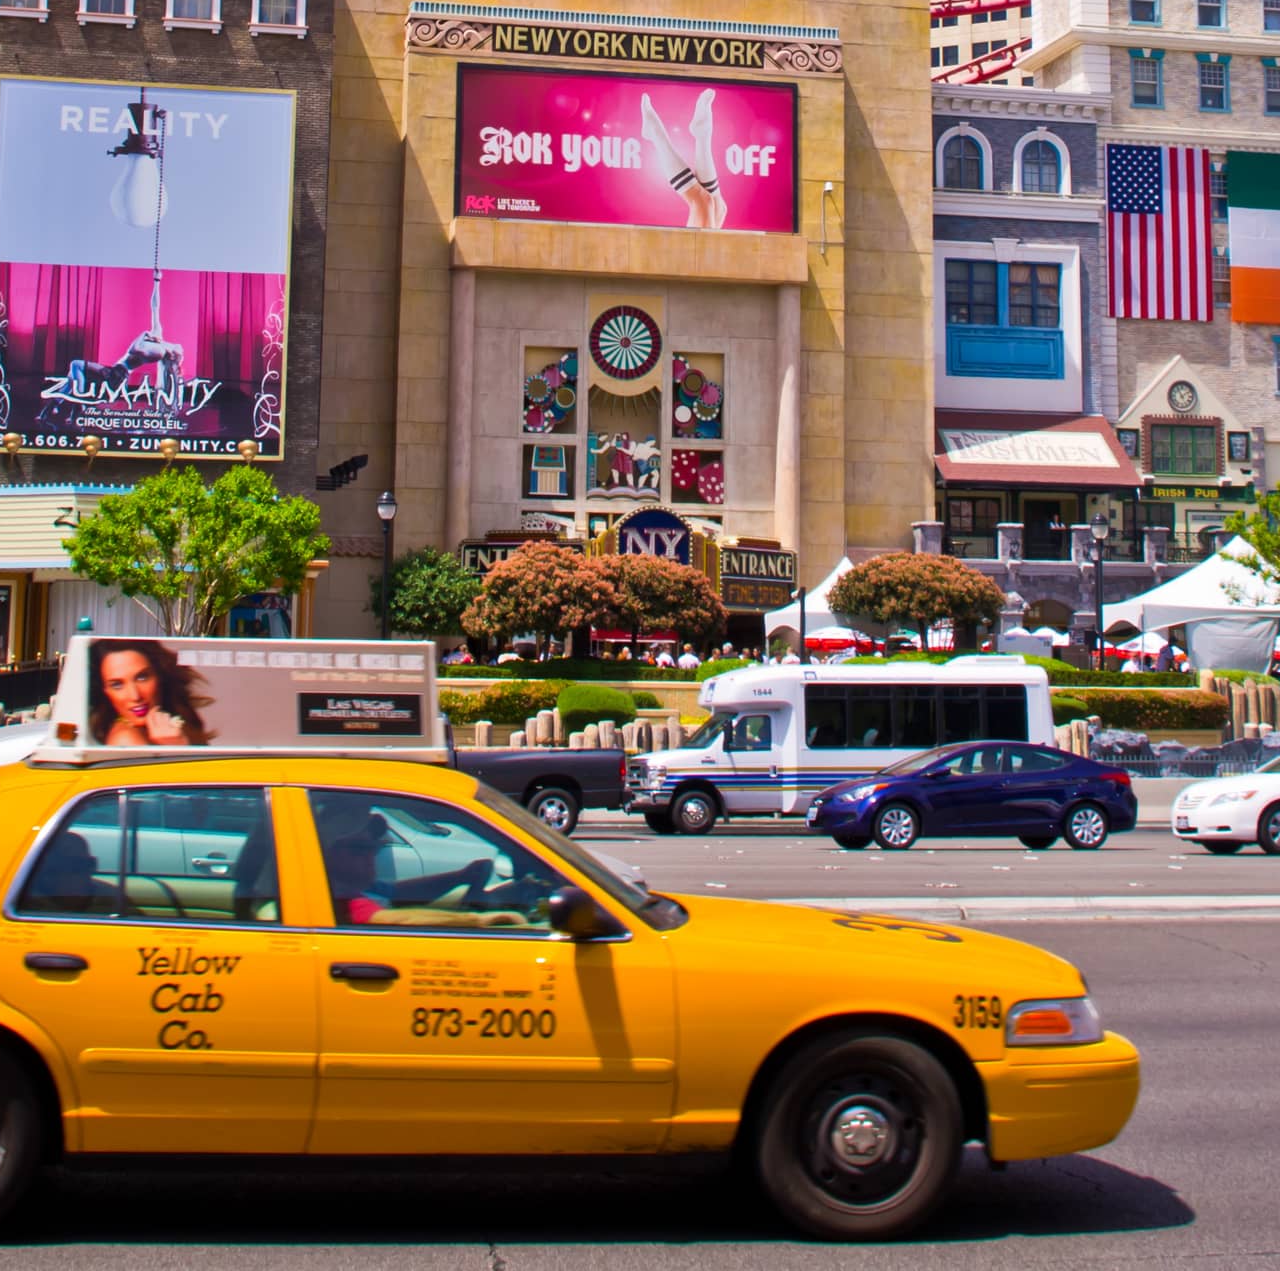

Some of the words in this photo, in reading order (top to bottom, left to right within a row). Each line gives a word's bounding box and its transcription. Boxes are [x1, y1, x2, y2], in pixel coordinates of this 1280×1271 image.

[495, 26, 554, 53] NEW
[557, 30, 628, 58] YORK
[631, 35, 690, 61] NEW
[693, 38, 763, 66] YORK
[60, 105, 229, 140] REALITY
[726, 144, 776, 177] OFF
[76, 417, 120, 430] CIRQUE
[123, 418, 140, 428] DU
[1153, 487, 1186, 497] IRISH
[1194, 488, 1219, 498] PUB
[623, 528, 686, 559] NY
[722, 552, 793, 577] ENTRANCE
[137, 947, 241, 976] Yellow
[150, 982, 224, 1013] Cab
[953, 994, 1001, 1029] 3159
[157, 1019, 213, 1050] Co.
[411, 1007, 557, 1038] 873-2000
